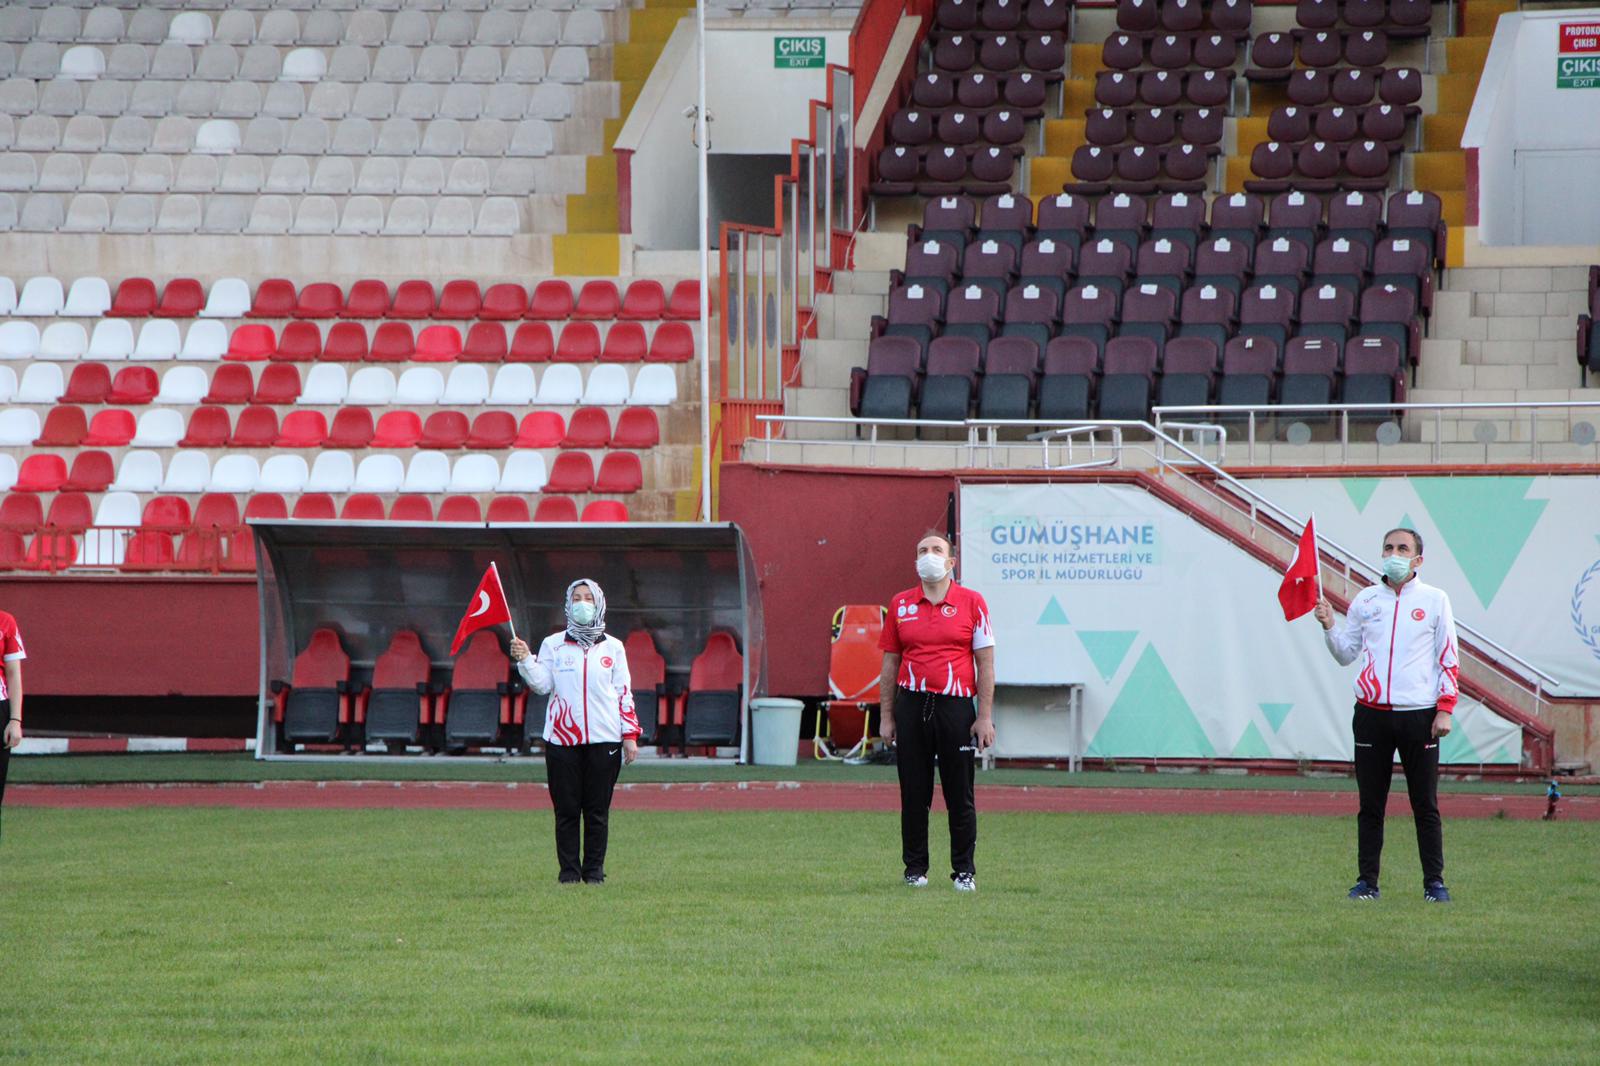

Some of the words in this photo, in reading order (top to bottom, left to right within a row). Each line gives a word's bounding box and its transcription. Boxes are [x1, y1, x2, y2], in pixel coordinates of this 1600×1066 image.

[779, 39, 821, 56] ÇIKIŞ
[790, 58, 810, 67] EXIT
[1573, 79, 1595, 88] EXIT
[990, 520, 1154, 551] GÜMÜŞHANE
[991, 551, 1049, 567] GENÇLİK
[1053, 551, 1133, 564] HİZMETLERİ
[1136, 553, 1153, 564] VE
[1001, 568, 1036, 580] SPOR
[1039, 566, 1051, 580] İL
[1055, 566, 1143, 580] MÜDÜRLÜĞÜ
